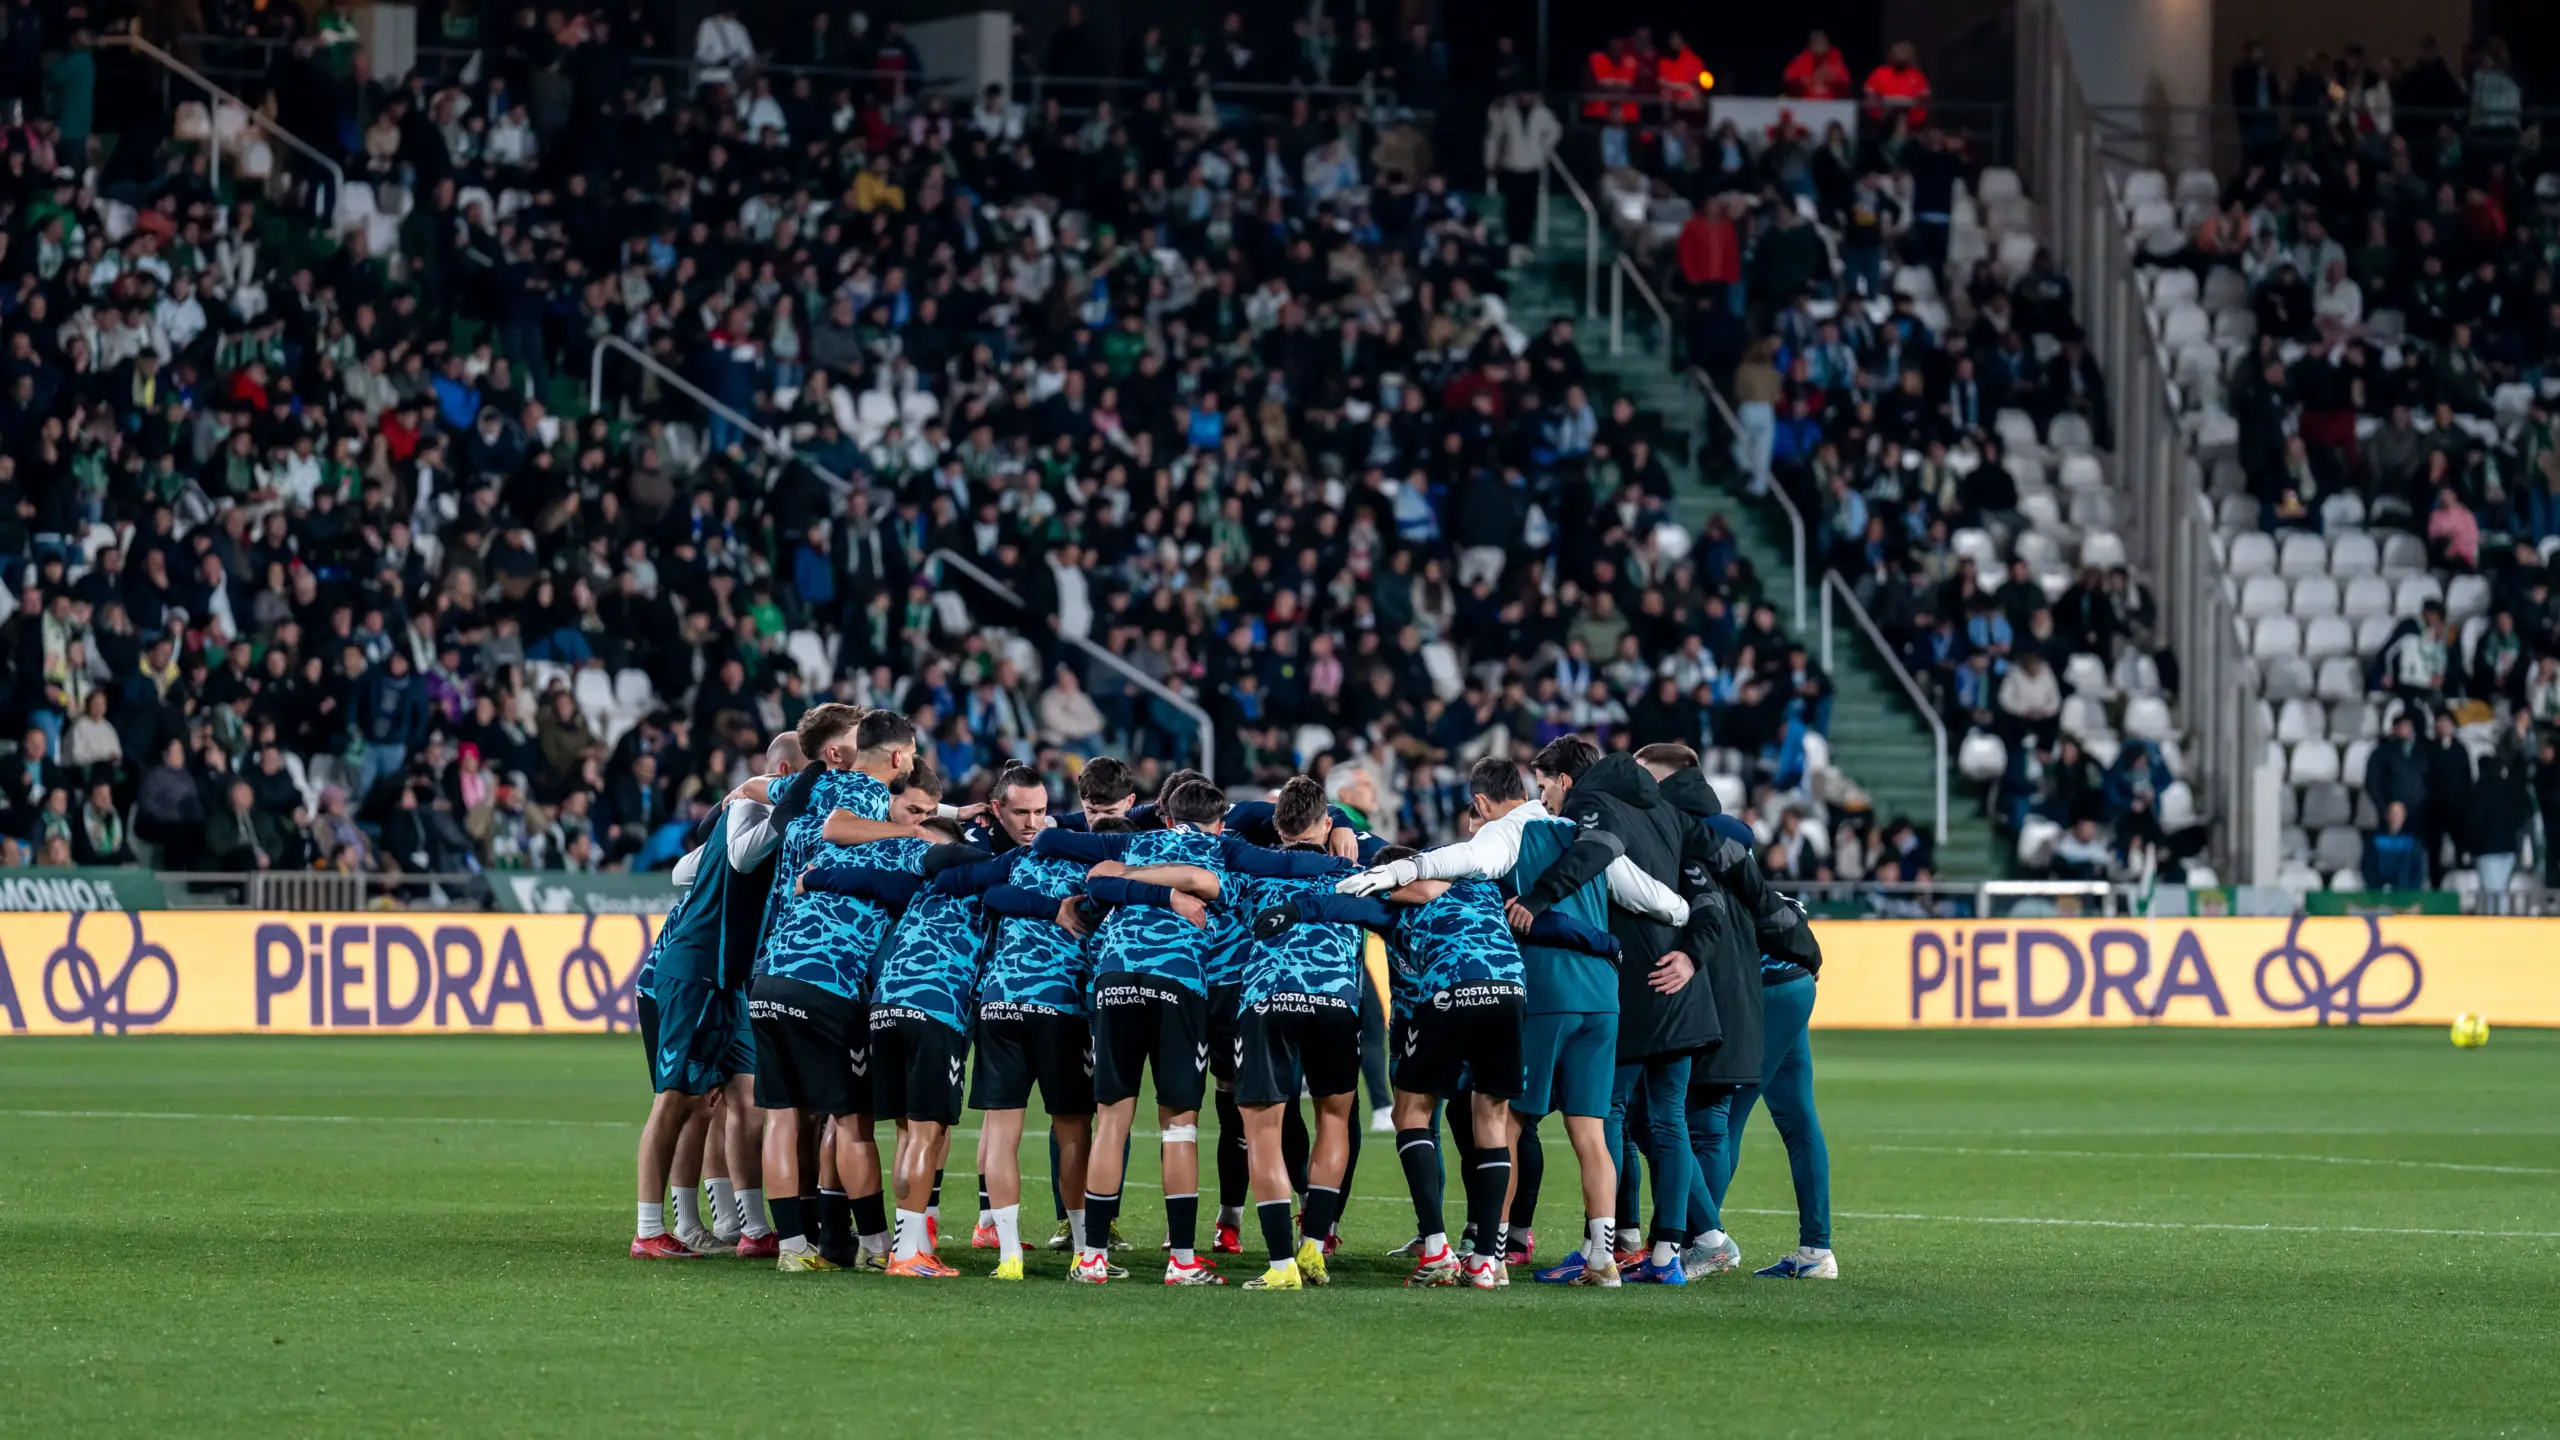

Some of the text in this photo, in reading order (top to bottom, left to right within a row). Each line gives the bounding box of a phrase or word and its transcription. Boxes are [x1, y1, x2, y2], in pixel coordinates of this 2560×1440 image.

[1105, 986, 1179, 1005] COSTA DEL SOL
[1454, 986, 1490, 997] COSTA
[1492, 986, 1512, 995] DEL
[1272, 992, 1347, 1008] COSTA DEL SOL
[1456, 996, 1499, 1008] MÁLAGA
[770, 1001, 787, 1013] DEL
[788, 1007, 808, 1020] SOL
[890, 1008, 905, 1018] DEL
[906, 1009, 927, 1021] SOL
[988, 1001, 1018, 1010] COSTA
[1037, 1005, 1058, 1016] SOL
[1273, 1001, 1316, 1014] MÁLAGA
